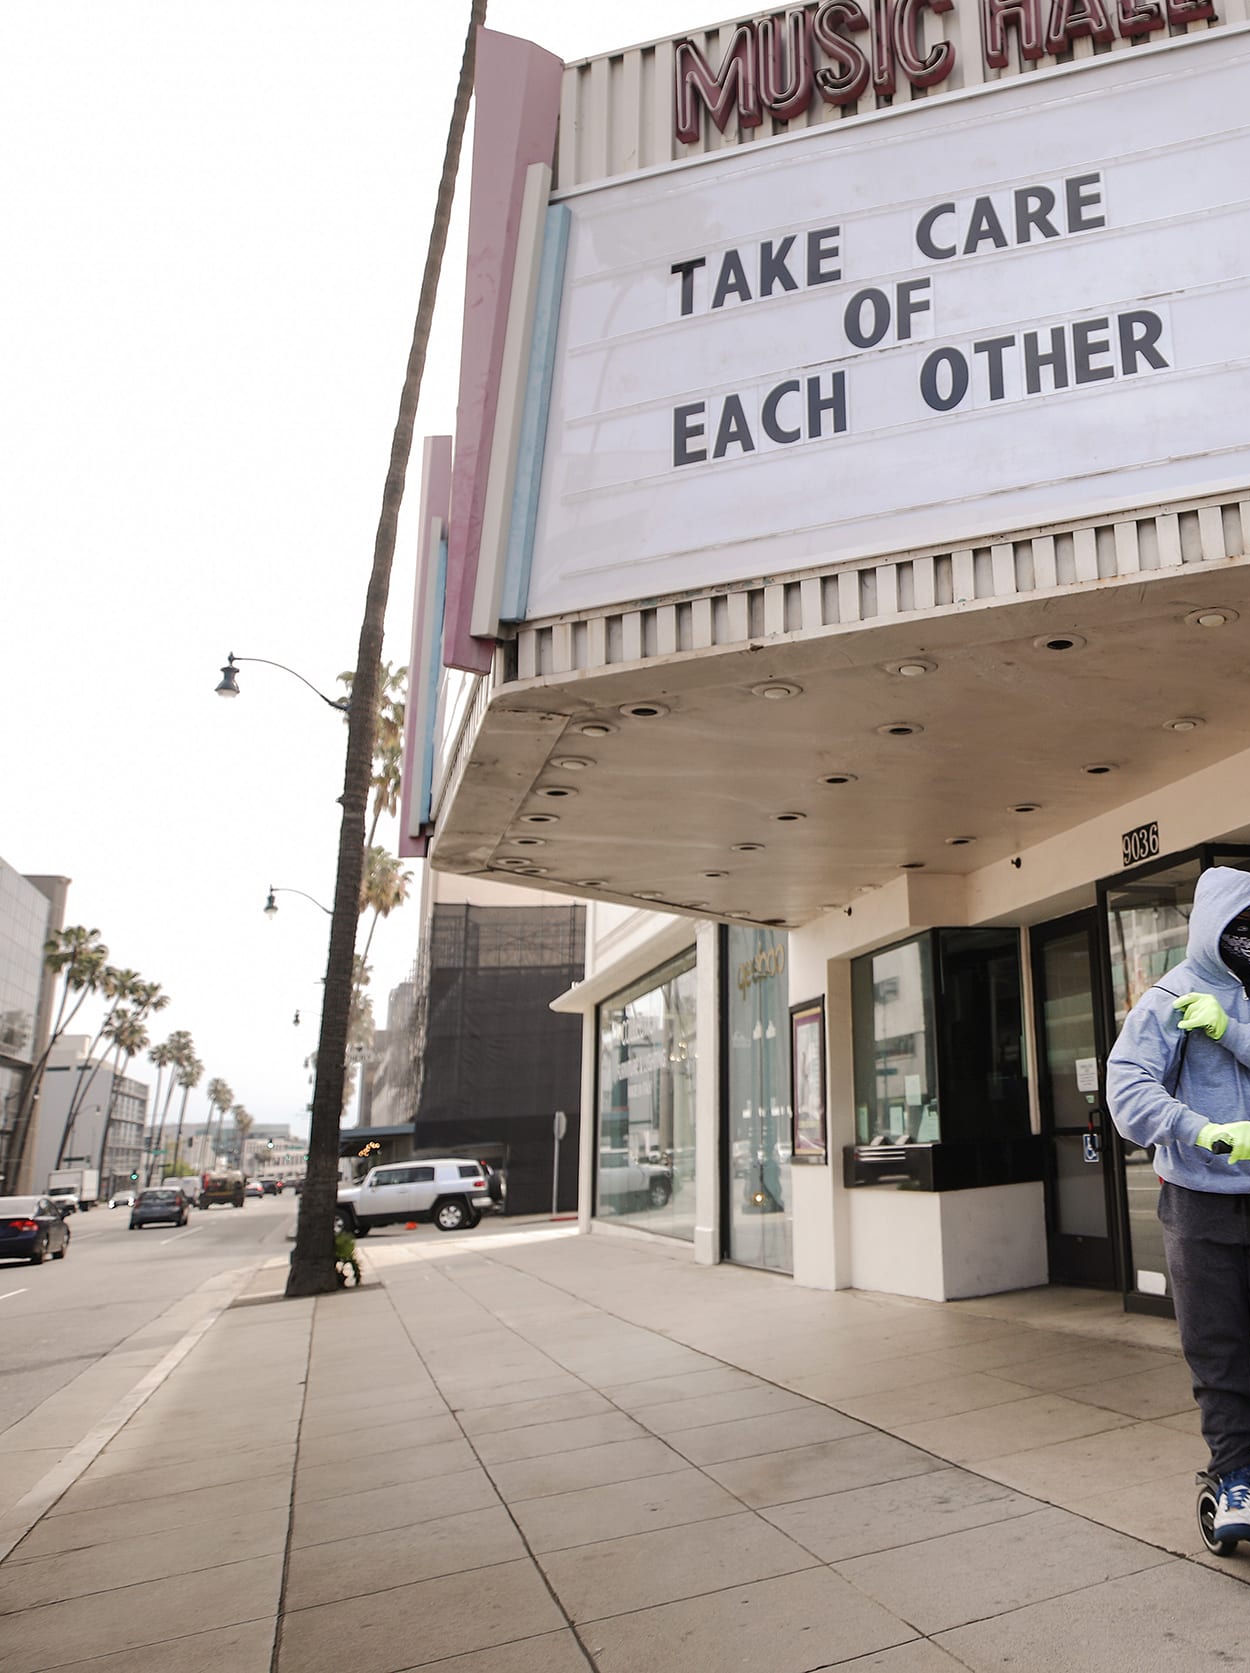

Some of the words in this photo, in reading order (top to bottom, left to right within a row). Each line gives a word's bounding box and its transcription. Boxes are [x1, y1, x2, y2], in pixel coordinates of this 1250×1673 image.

[674, 0, 956, 144] MUSIC
[984, 0, 1214, 68] HA
[671, 226, 841, 316] TAKE
[915, 172, 1105, 260] CARE
[844, 277, 931, 348] OF
[673, 370, 847, 467] EACH
[919, 310, 1170, 411] OTHER
[1122, 823, 1159, 864] 9036
